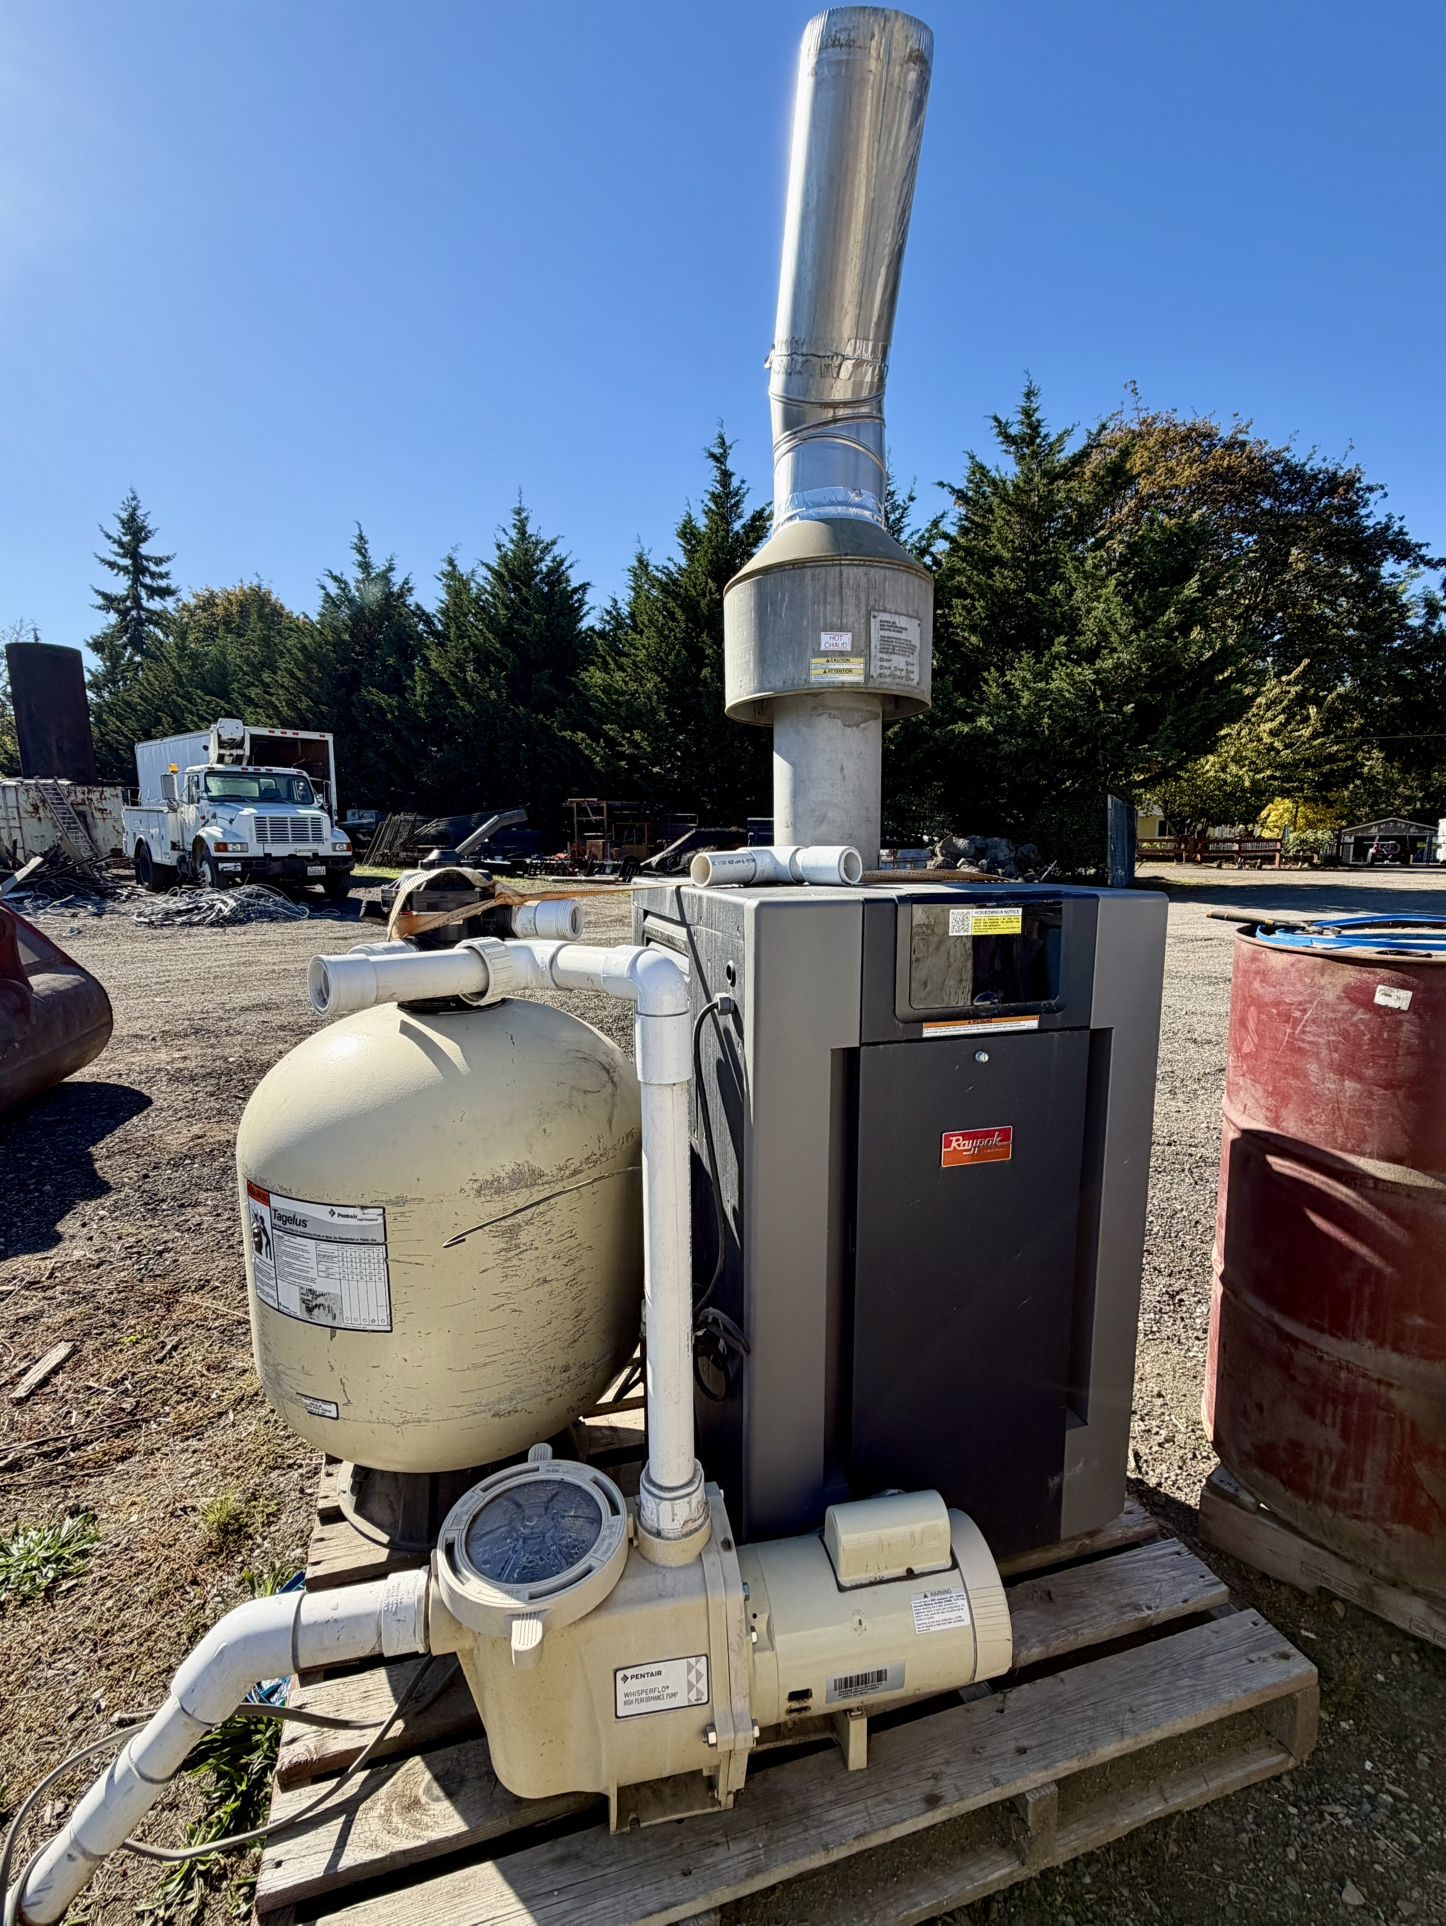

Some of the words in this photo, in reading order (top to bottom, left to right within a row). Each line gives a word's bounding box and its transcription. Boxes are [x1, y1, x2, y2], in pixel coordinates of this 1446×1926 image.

[829, 634, 843, 642] HOT
[948, 1131, 1004, 1155] Raypak
[272, 1208, 308, 1228] Tagelus
[930, 1588, 952, 1598] WARNING
[630, 1670, 662, 1681] PENTAIR
[624, 1698, 634, 1706] HIGH
[634, 1694, 665, 1704] PERFORMANCE
[665, 1691, 678, 1700] PUMP
